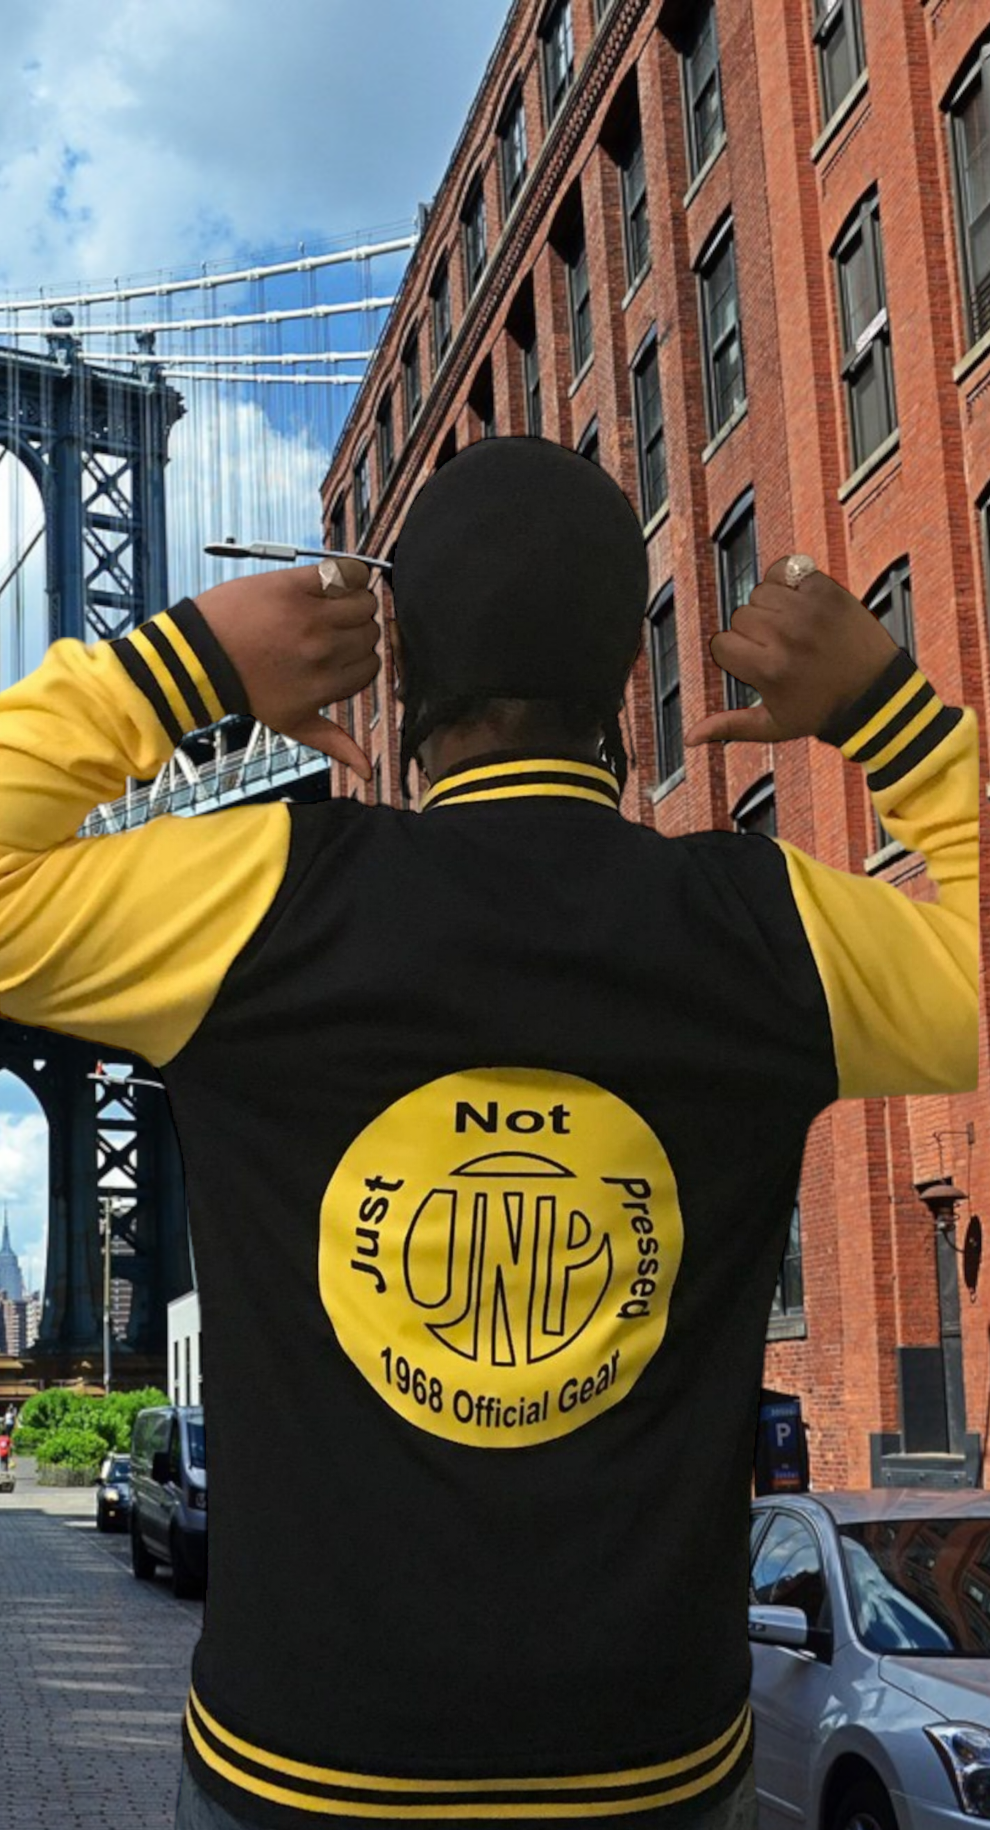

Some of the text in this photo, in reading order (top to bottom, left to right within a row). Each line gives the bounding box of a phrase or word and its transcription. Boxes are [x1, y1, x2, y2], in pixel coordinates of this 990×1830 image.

[351, 1101, 660, 1319] Just Not Pressed
[380, 1346, 621, 1429] 1968 Official Gear
[775, 1422, 792, 1447] P
